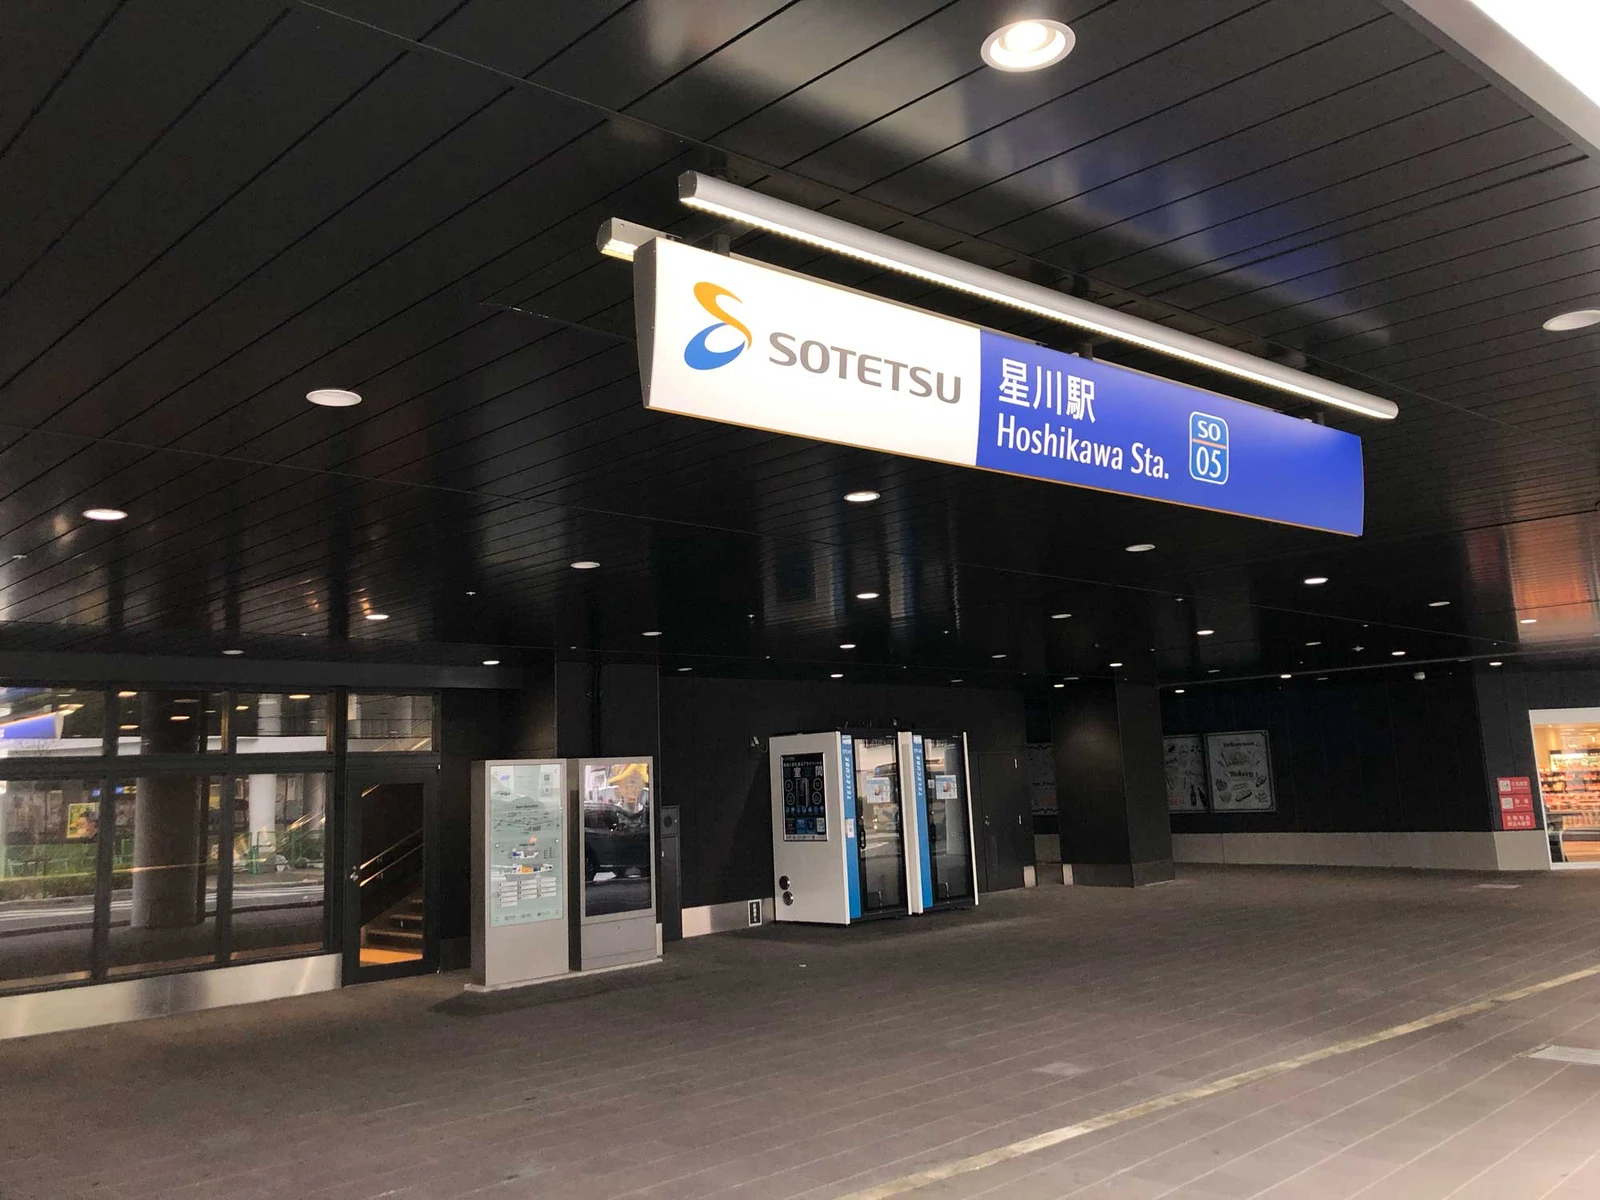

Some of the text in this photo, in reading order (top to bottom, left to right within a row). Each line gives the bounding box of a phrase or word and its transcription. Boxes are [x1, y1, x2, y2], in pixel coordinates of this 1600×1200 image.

[769, 331, 962, 404] SOTETSU
[998, 357, 1097, 424] 星川駅
[996, 412, 1170, 481] Hoshikawa Sta.
[1197, 419, 1221, 442] SO
[1196, 445, 1222, 479] 05
[844, 757, 852, 800] TELECUBE
